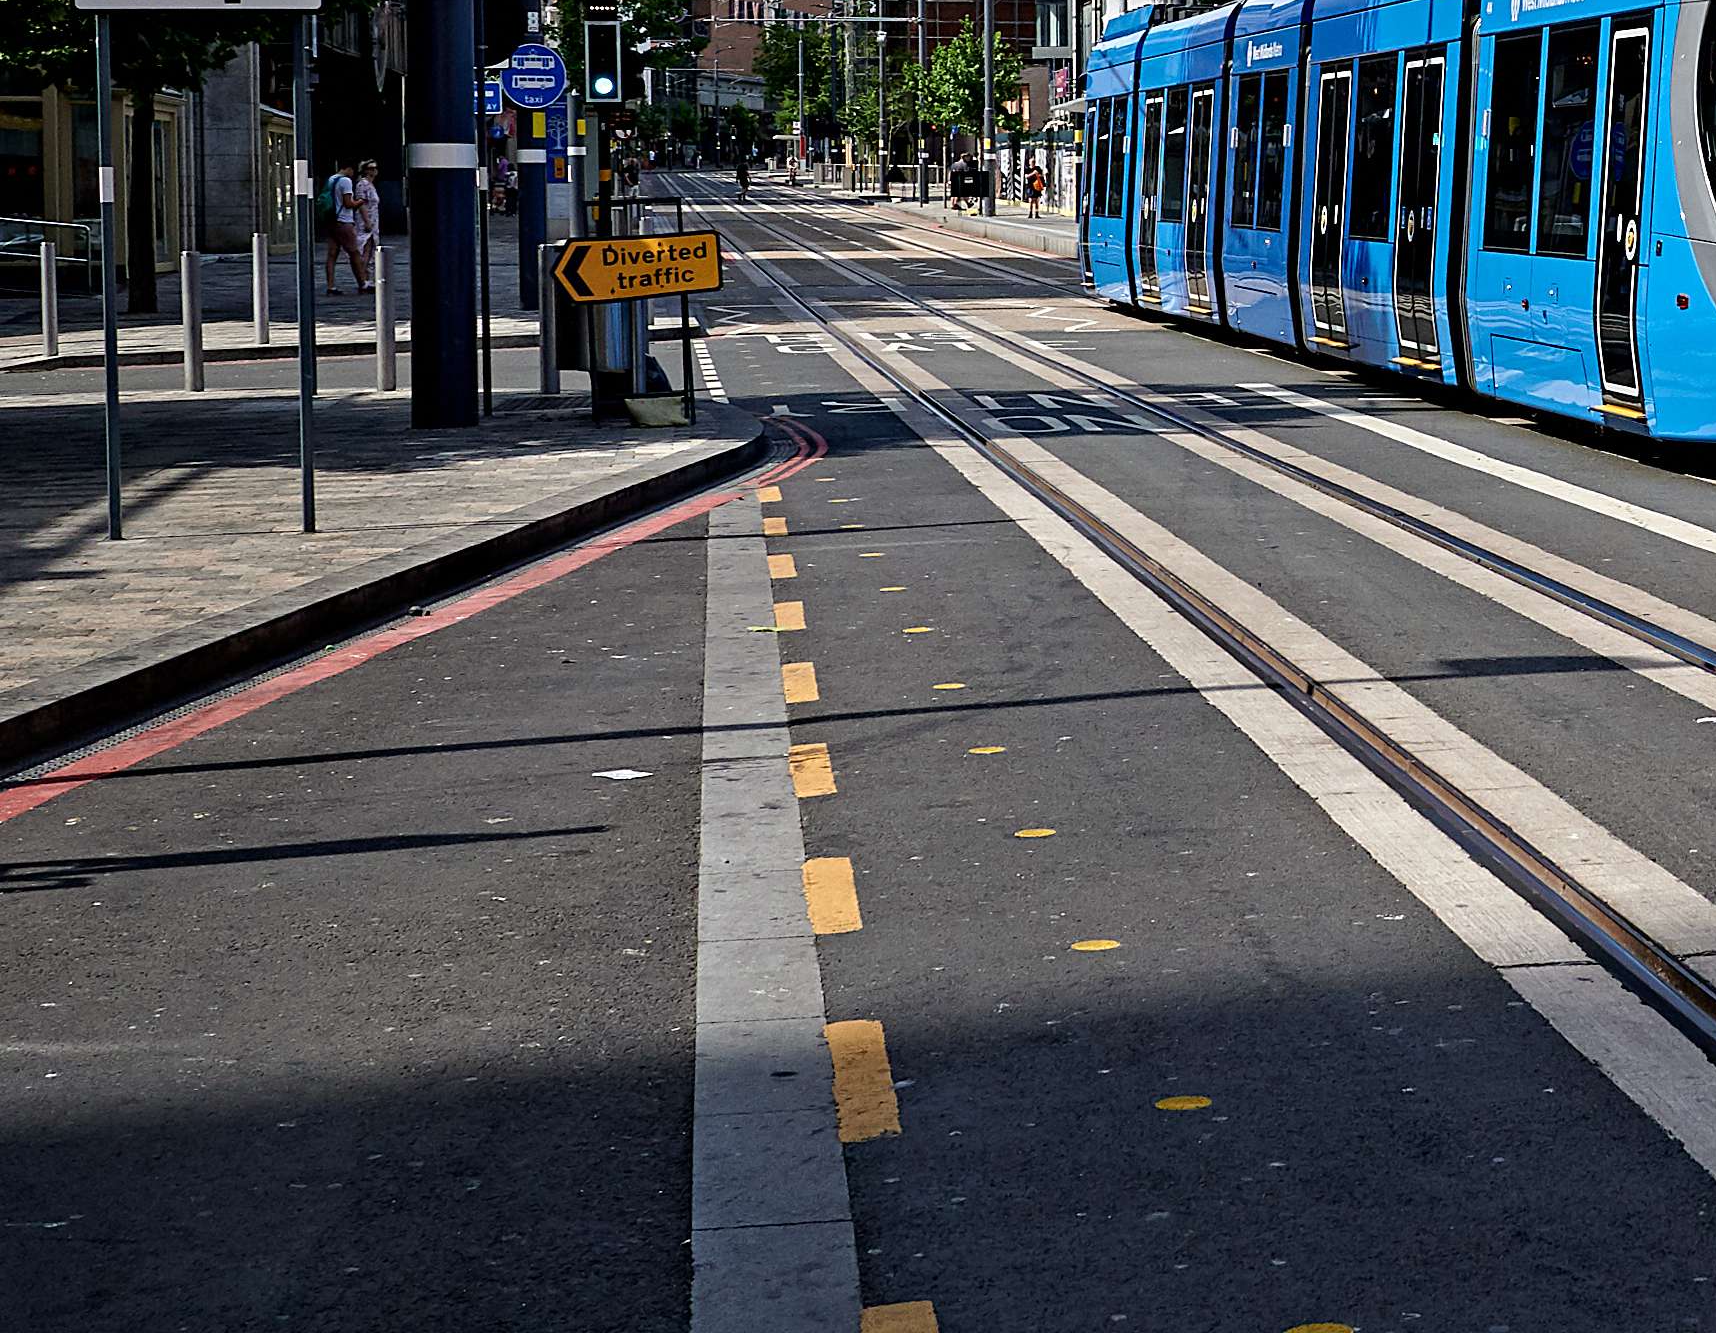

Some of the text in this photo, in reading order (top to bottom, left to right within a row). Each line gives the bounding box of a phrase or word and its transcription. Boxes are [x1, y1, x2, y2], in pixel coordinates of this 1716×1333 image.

[524, 94, 543, 104] taxi
[602, 242, 707, 267] Diverted
[617, 267, 696, 290] traffic
[763, 331, 975, 343] BUS
